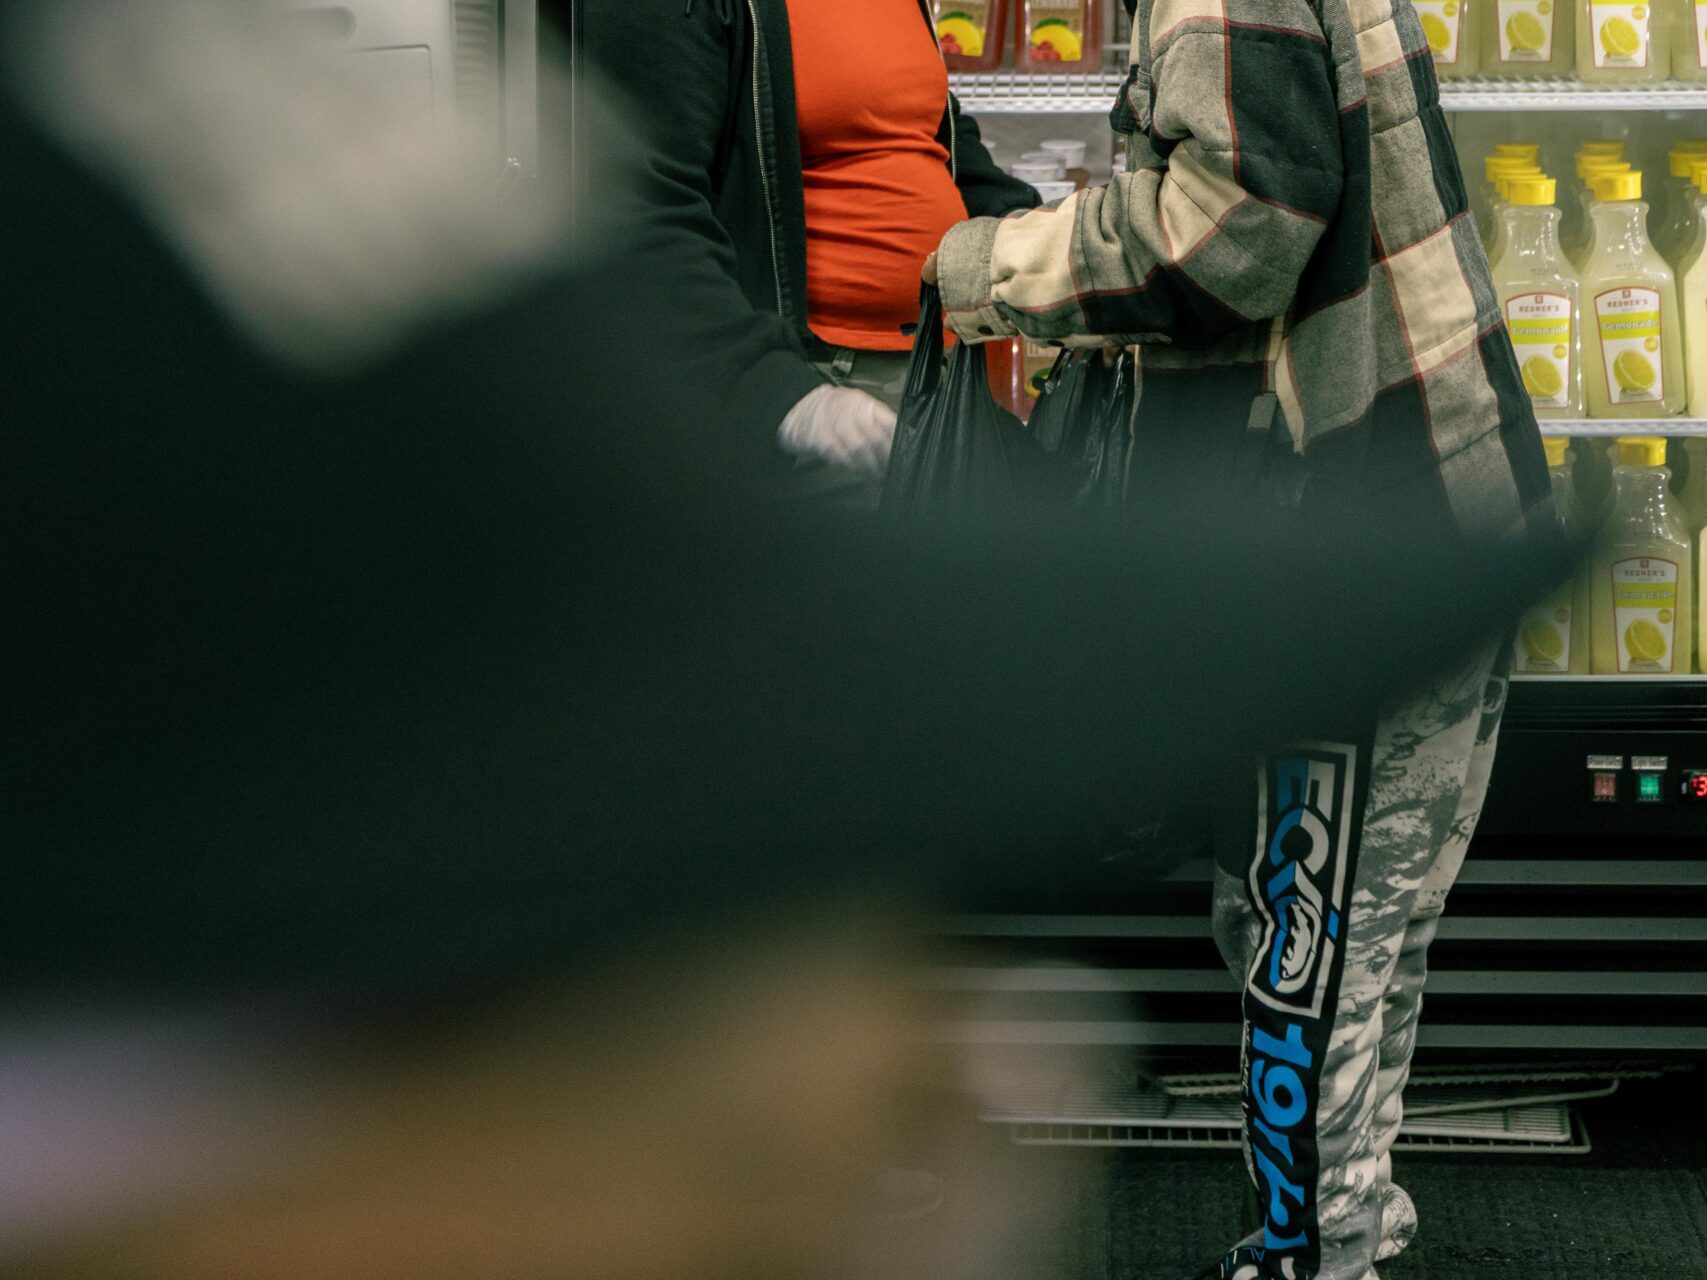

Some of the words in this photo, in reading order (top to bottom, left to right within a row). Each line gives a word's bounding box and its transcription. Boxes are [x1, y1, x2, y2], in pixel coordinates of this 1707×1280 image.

[1607, 299, 1649, 308] REDNER'S
[1518, 305, 1560, 313] REDNER'S
[1602, 319, 1657, 332] Lemonade
[1511, 325, 1568, 336] Lemonade
[1624, 569, 1666, 577] REDNER'S
